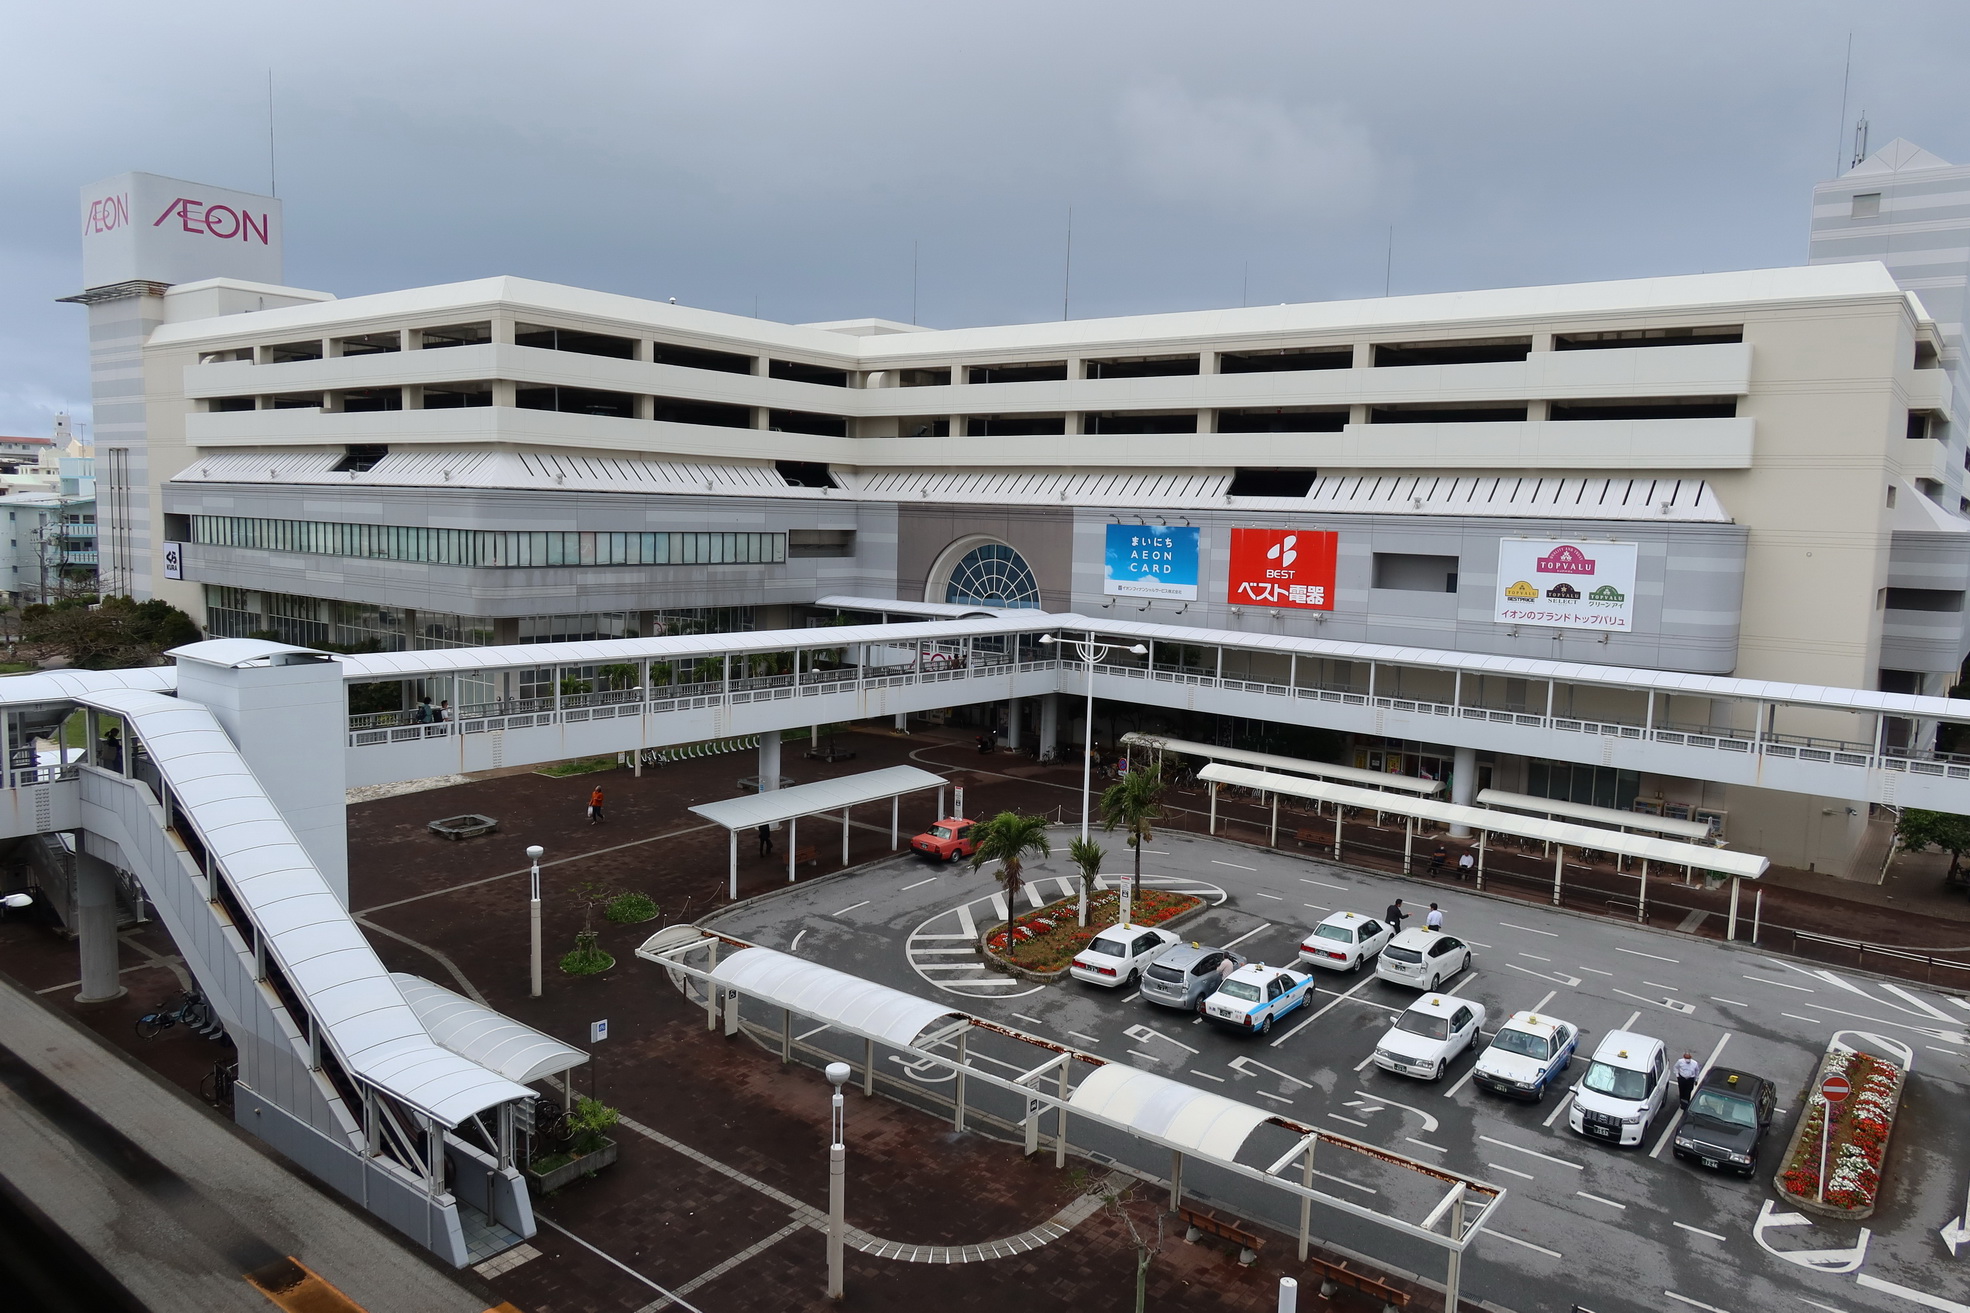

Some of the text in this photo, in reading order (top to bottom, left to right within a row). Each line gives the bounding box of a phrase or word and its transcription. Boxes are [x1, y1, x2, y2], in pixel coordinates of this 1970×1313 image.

[1131, 536, 1173, 548] まいにち
[1130, 550, 1172, 560] AEON
[1130, 563, 1171, 573] CARD
[1540, 561, 1591, 571] TOPVALU
[1266, 569, 1295, 579] BEST
[1238, 582, 1324, 605] ベスト電器
[1501, 609, 1625, 627] イオンのブランド トップバリュ
[1482, 1065, 1527, 1080] TAXI
